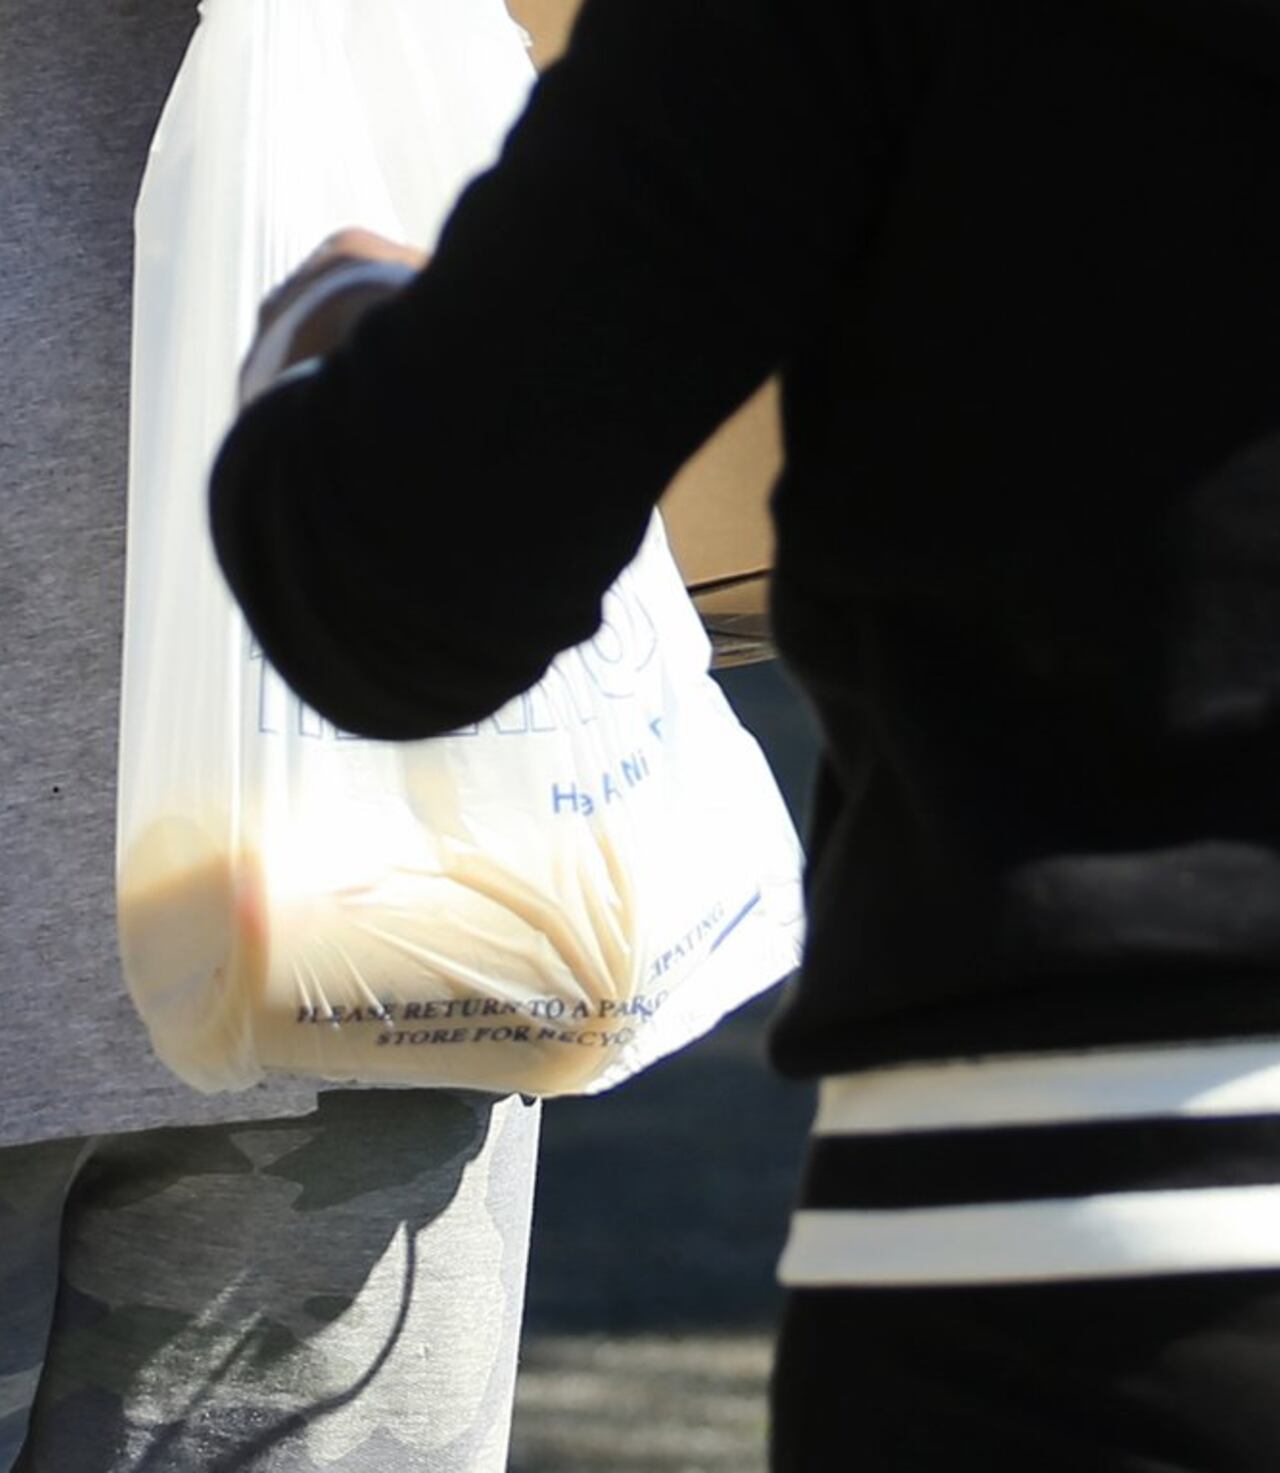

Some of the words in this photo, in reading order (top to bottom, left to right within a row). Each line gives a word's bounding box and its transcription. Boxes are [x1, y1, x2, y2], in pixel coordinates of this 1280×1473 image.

[403, 996, 520, 1020] RETURN
[527, 997, 565, 1020] TO
[572, 998, 590, 1019] A
[375, 1026, 468, 1047] STORE
[473, 1025, 532, 1044] FOR
